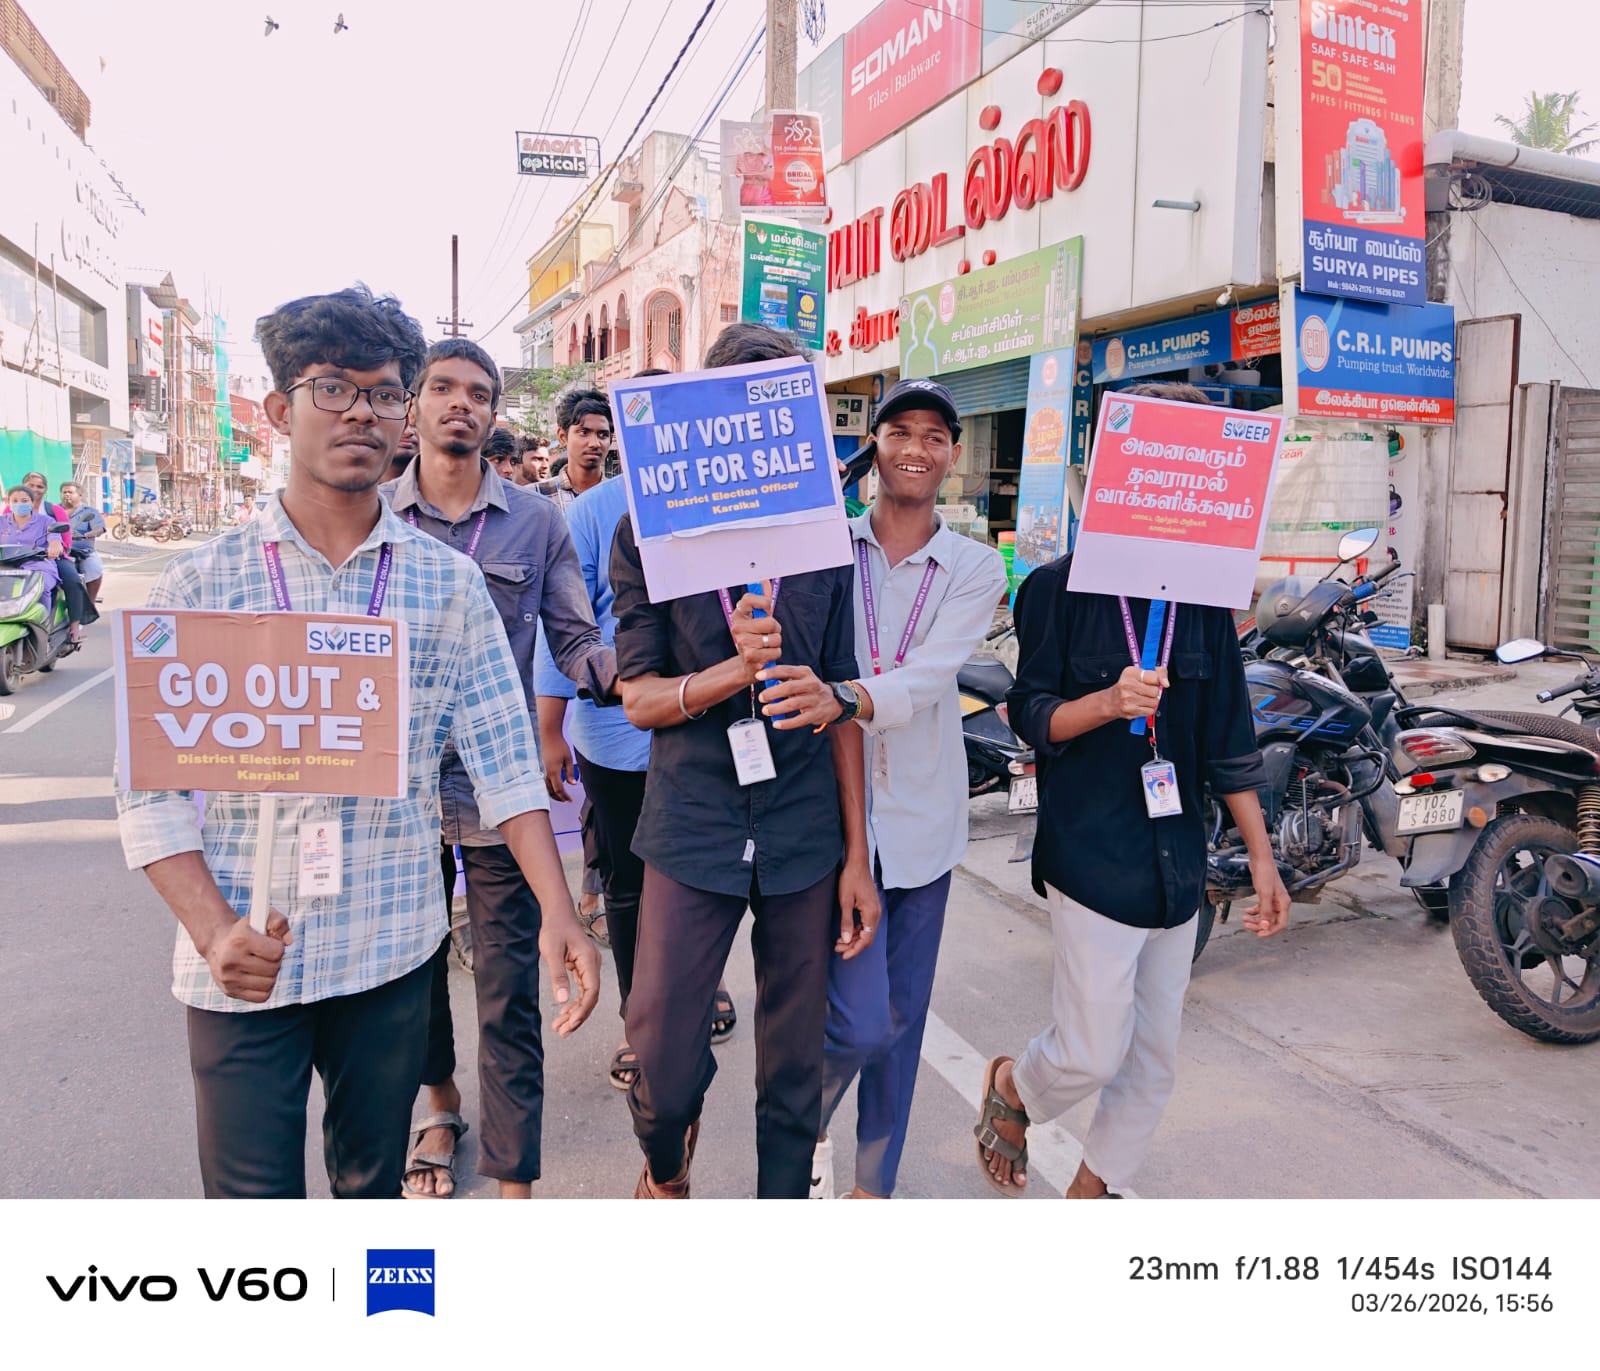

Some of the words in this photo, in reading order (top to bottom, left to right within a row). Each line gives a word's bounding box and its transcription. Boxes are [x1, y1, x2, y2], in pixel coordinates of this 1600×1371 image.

[1311, 0, 1396, 59] Sintex
[1311, 42, 1337, 58] SAAF
[1342, 51, 1368, 68] SAFE
[1373, 60, 1396, 75] SAHI
[868, 88, 888, 112] Tiles
[895, 50, 941, 92] Bathware
[1312, 59, 1342, 91] 50
[1311, 92, 1336, 107] PIPES
[1344, 100, 1381, 118] FITTINGS
[1390, 111, 1415, 126] TANKS
[522, 138, 583, 155] smart
[521, 154, 587, 173] opticals
[1308, 227, 1358, 253] சூர்யா
[1365, 240, 1421, 263] பைப்ஸ்
[1312, 255, 1368, 279] SURYA
[1372, 264, 1419, 287] PIPES
[826, 330, 842, 356] &
[1128, 341, 1160, 360] C.R.I.
[1161, 330, 1211, 354] PUMPS
[1336, 329, 1386, 356] C.R.I.
[1391, 336, 1453, 363] PUMPS
[1337, 355, 1380, 375] Pumping
[1382, 361, 1405, 375] trust.
[1406, 362, 1453, 379] Worldwide.
[1315, 390, 1379, 409] இலக்கியா
[653, 421, 690, 454] MY
[696, 412, 764, 447] VOTE
[769, 406, 795, 437] IS
[1120, 437, 1247, 469] அனைவரும்
[638, 460, 689, 497] NOT
[695, 450, 748, 487] FOR
[752, 442, 815, 479] SALE
[1125, 466, 1228, 493] தவராமல்
[666, 494, 709, 509] District
[711, 488, 758, 502] Election
[760, 480, 799, 494] Officer
[712, 500, 760, 515] Karaikal
[1095, 486, 1254, 521] வாக்களிக்கவும்
[373, 580, 385, 608] SCIENCE
[379, 552, 391, 581] COLLEGE
[309, 626, 392, 655] SWEEP
[158, 662, 230, 708] GO
[244, 663, 341, 710] OUT
[356, 677, 382, 712] &
[153, 712, 365, 751] VOTE
[177, 754, 236, 766] District
[240, 754, 301, 767] Election
[305, 755, 356, 768] Officer
[237, 770, 300, 782] Karaikal
[1410, 813, 1417, 827] S
[1423, 807, 1456, 825] 4980
[1414, 794, 1448, 812] PY02
